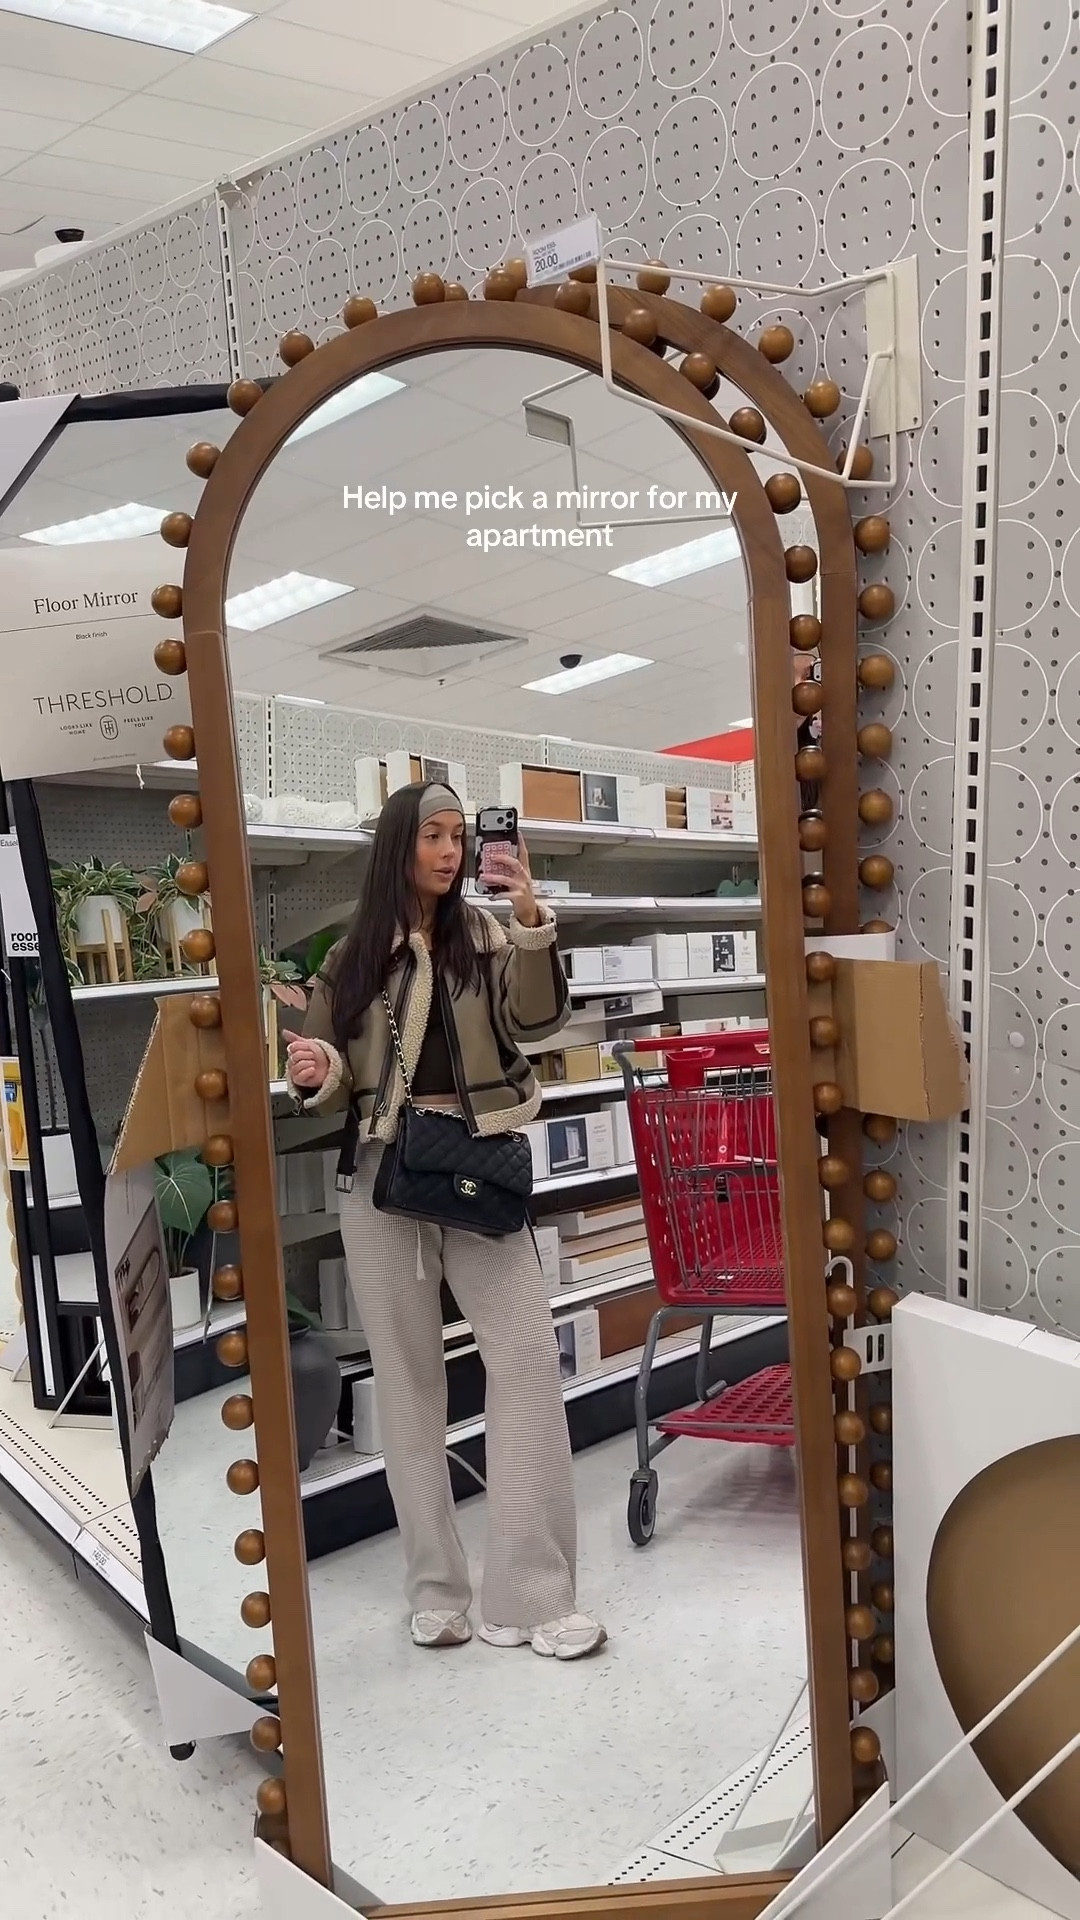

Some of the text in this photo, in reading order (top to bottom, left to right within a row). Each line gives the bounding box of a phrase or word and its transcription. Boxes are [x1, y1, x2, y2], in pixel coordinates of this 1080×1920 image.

[535, 253, 558, 272] 20.00
[33, 591, 139, 614] Floor Mirror
[75, 630, 108, 641] Black finish
[33, 683, 173, 714] THRESHOLD
